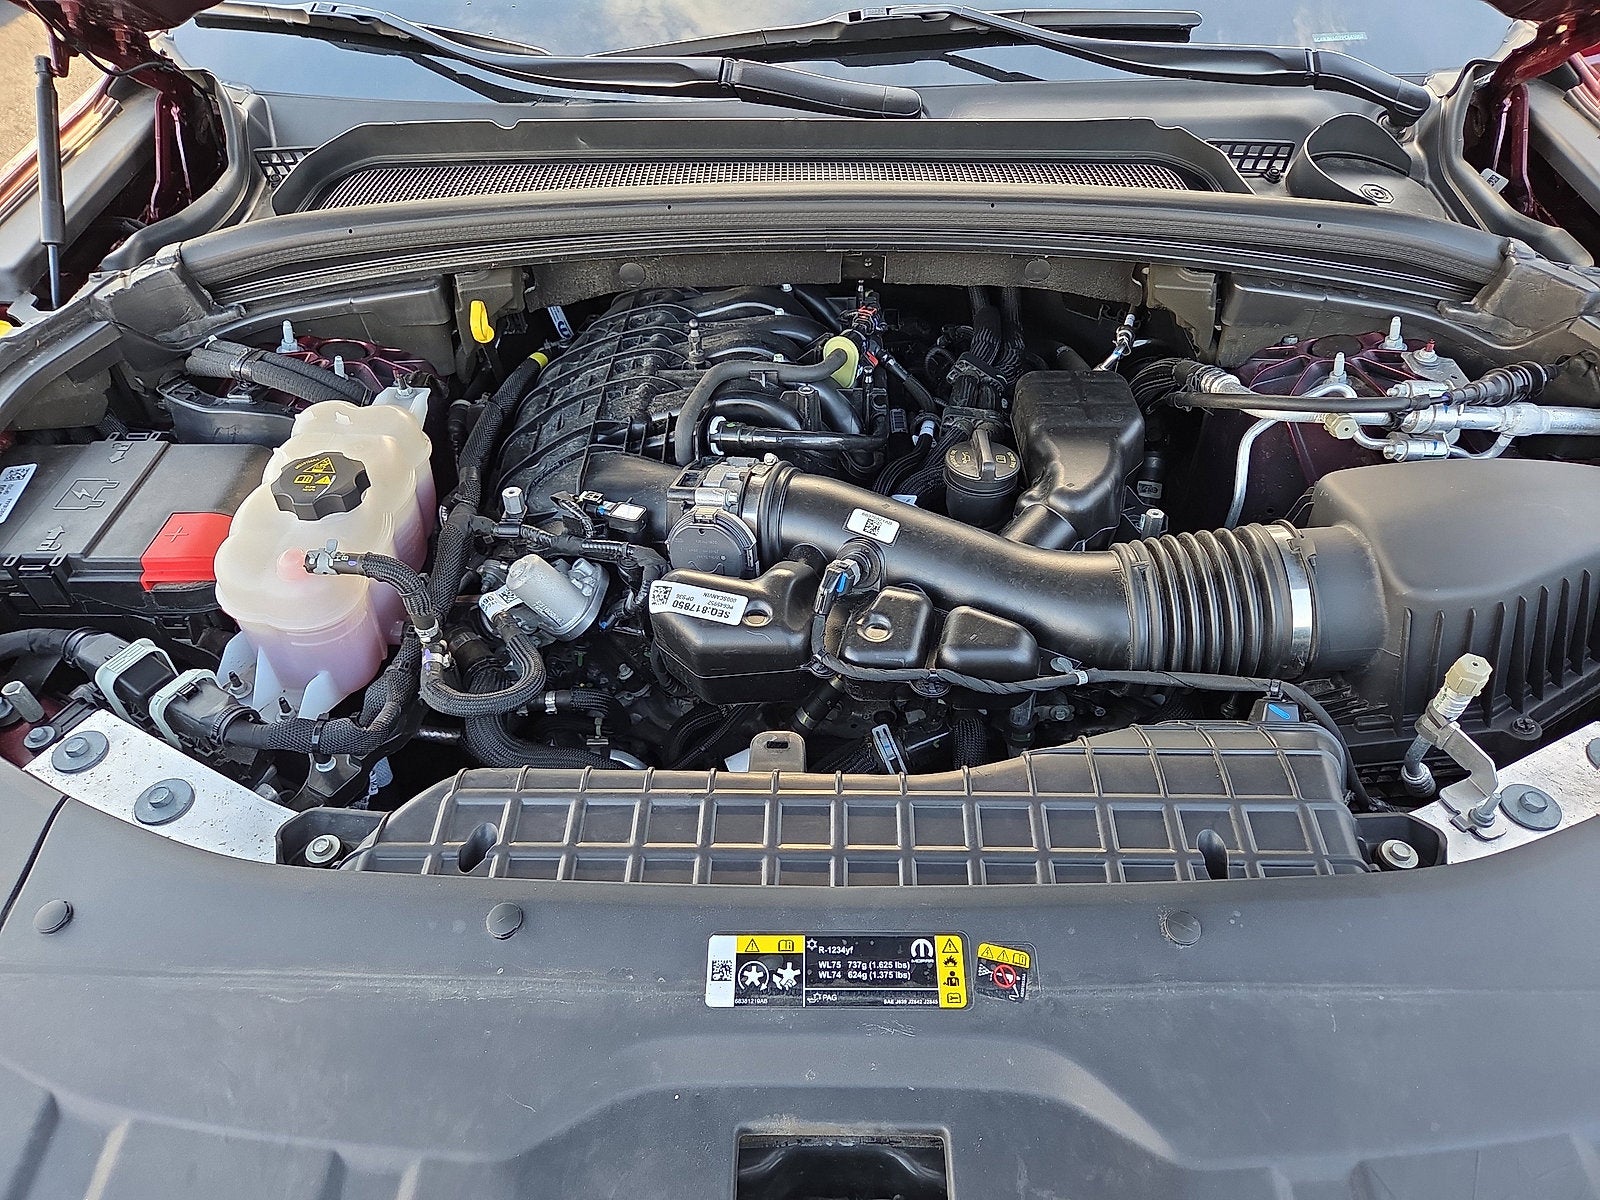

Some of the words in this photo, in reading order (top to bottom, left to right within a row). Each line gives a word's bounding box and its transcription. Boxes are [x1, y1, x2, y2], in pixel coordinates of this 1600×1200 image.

[671, 599, 731, 619] SEQ:817850
[818, 945, 854, 955] R-1234yf
[818, 961, 841, 969] WL75
[847, 961, 867, 970] 737g
[869, 961, 893, 970] (1.625
[895, 960, 910, 970] lbs)
[818, 971, 841, 979] WL74
[847, 971, 867, 980] 624g
[869, 971, 893, 980] (1.375
[895, 971, 911, 980] lbs)
